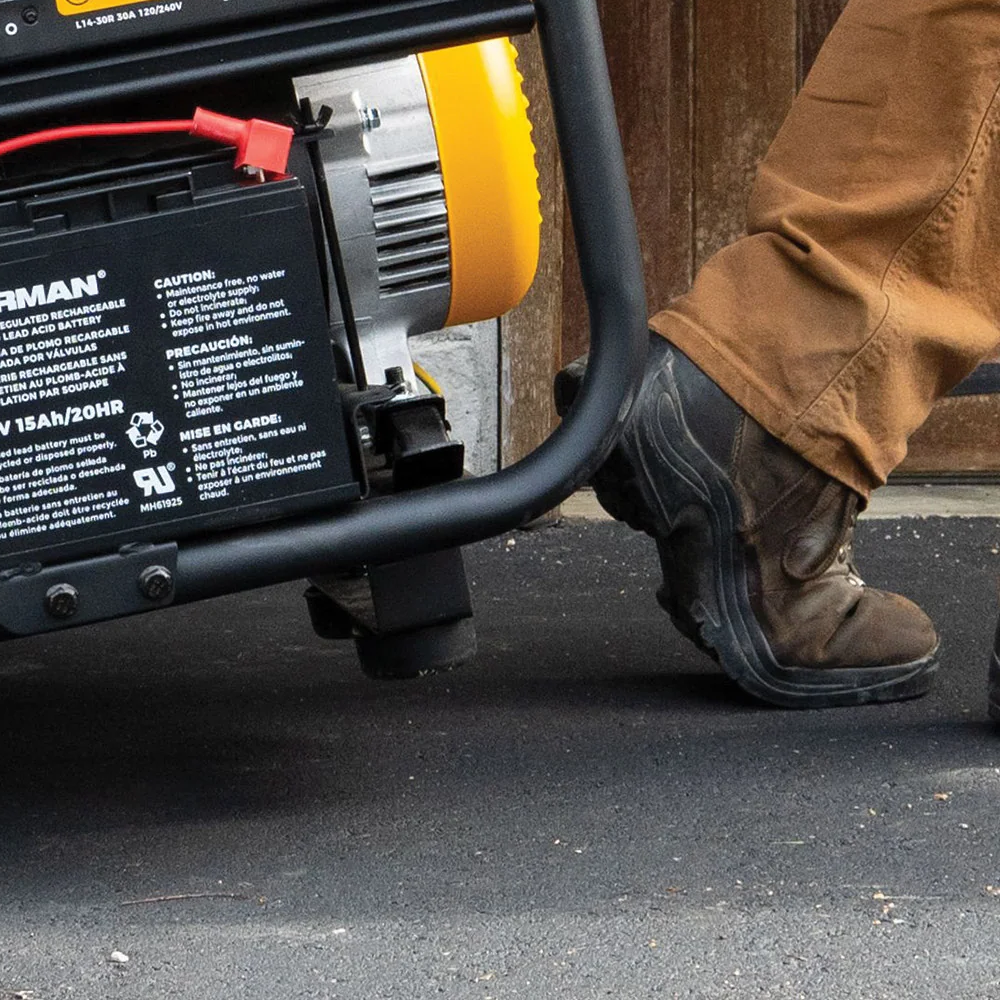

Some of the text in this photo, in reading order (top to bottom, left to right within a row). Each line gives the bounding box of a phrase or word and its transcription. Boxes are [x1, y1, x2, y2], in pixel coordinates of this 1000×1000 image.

[75, 1, 182, 29] L14-30R 30A 120/240V
[154, 269, 215, 289] CAUTION:
[50, 298, 125, 320] RECHARGEABLE
[2, 329, 29, 340] LEAD
[31, 324, 55, 335] ACID
[57, 314, 101, 330] BATTERY
[9, 345, 23, 355] DE
[25, 338, 62, 352] PLOMO
[64, 325, 130, 344] RECARGABLE
[166, 335, 252, 359] PRECAUCIÓN:
[19, 357, 98, 379] RECHARGEABLE
[99, 351, 127, 363] SANS
[22, 352, 44, 364] POR
[45, 342, 97, 359] VÁLVULAS
[29, 379, 43, 389] AU
[45, 365, 115, 385] PLOMB-ACIDE
[117, 362, 125, 372] À
[39, 387, 59, 398] PAR
[61, 378, 108, 394] SOUPAPE
[15, 399, 124, 432] 15Ah/20HR
[179, 413, 281, 441] MISE EN GARDE:
[142, 448, 158, 460] Pb
[140, 497, 183, 513] MH61925
